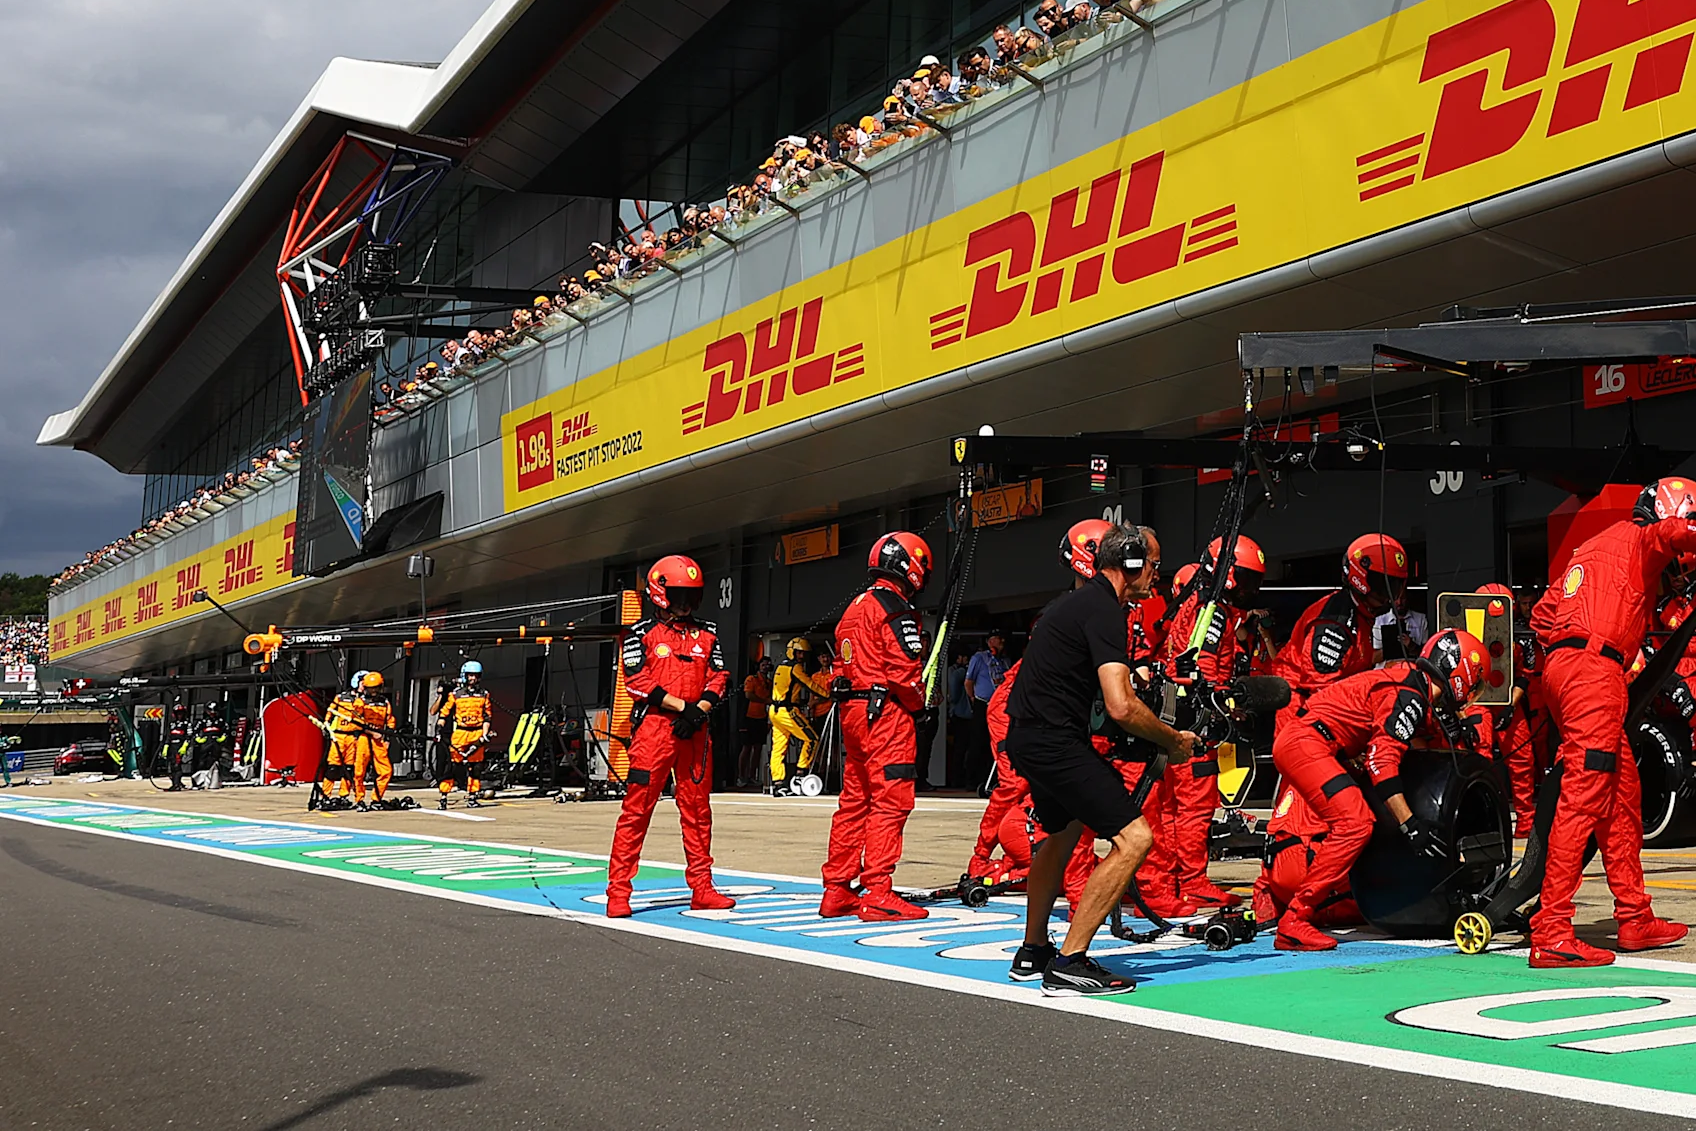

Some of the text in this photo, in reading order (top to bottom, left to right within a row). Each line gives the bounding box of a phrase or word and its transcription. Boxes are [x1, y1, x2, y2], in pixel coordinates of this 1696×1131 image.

[963, 150, 1187, 339] DHL
[703, 296, 835, 428] DHL
[1594, 363, 1626, 396] 16
[561, 411, 593, 445] DHL
[519, 430, 551, 475] 1.98s
[556, 430, 643, 479] FASTEST PIT STOP 2022
[224, 539, 256, 594] DHL
[719, 577, 733, 609] 33
[296, 634, 342, 643] DP WORLD
[1317, 653, 1337, 667] VGW
[1648, 726, 1676, 765] ZERO
